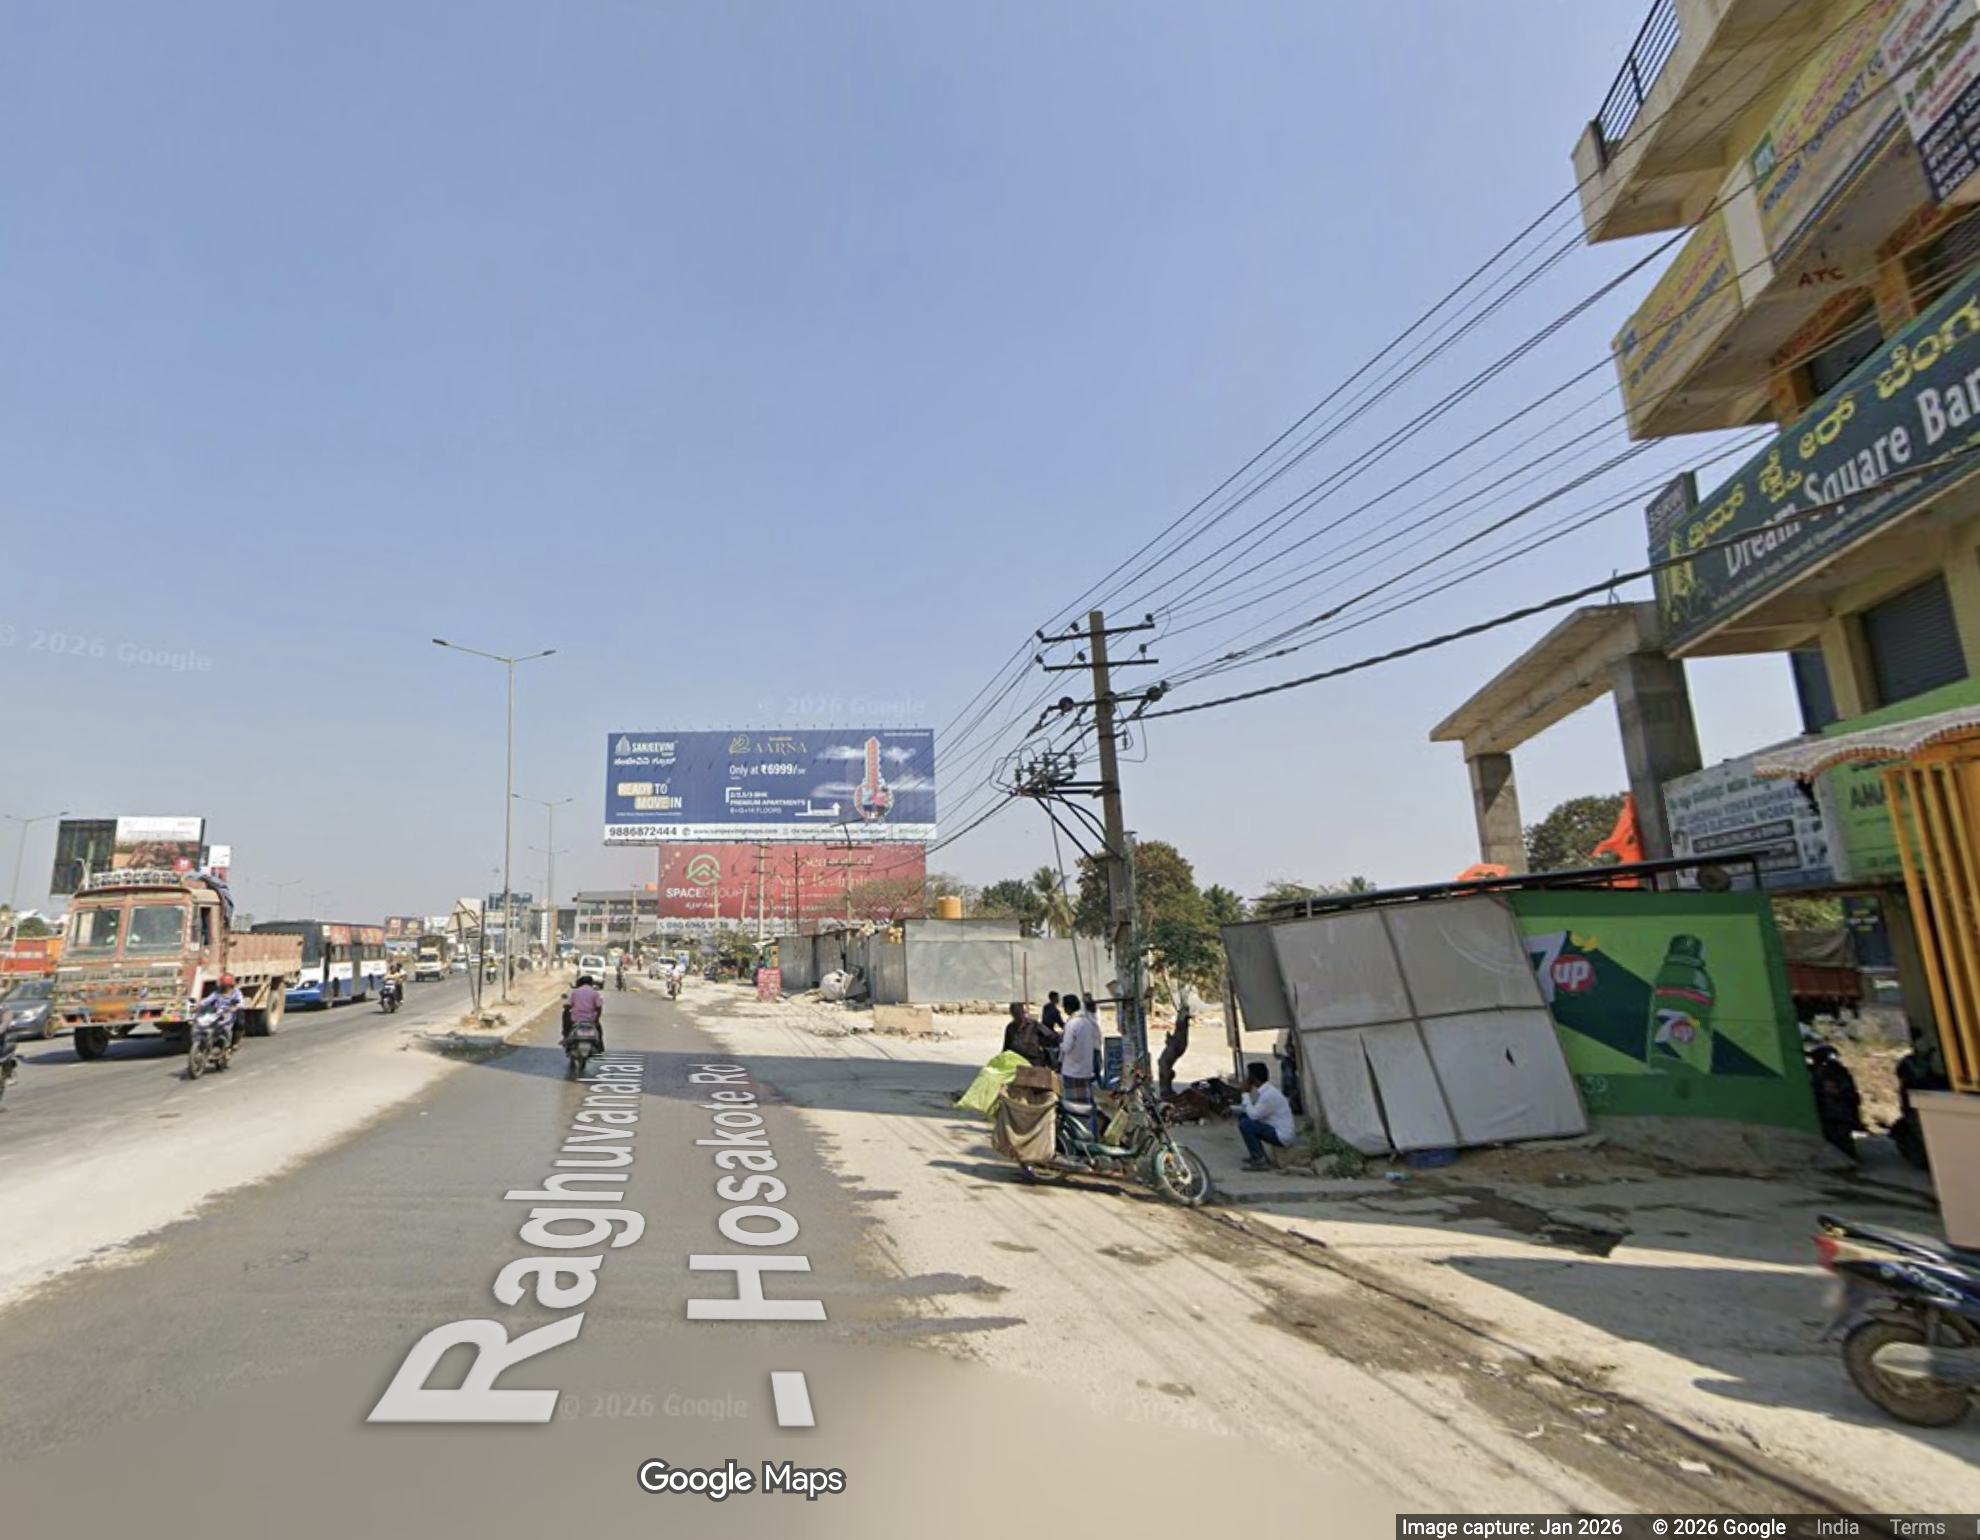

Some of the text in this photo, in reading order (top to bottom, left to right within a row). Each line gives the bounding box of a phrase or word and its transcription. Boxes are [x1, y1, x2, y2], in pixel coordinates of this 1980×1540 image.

[1804, 423, 1912, 519] Square
[729, 765, 748, 777] Only
[750, 765, 759, 775] at
[618, 783, 668, 796] READY TO
[636, 796, 682, 809] MOVE IN
[609, 826, 678, 836] 9886872444
